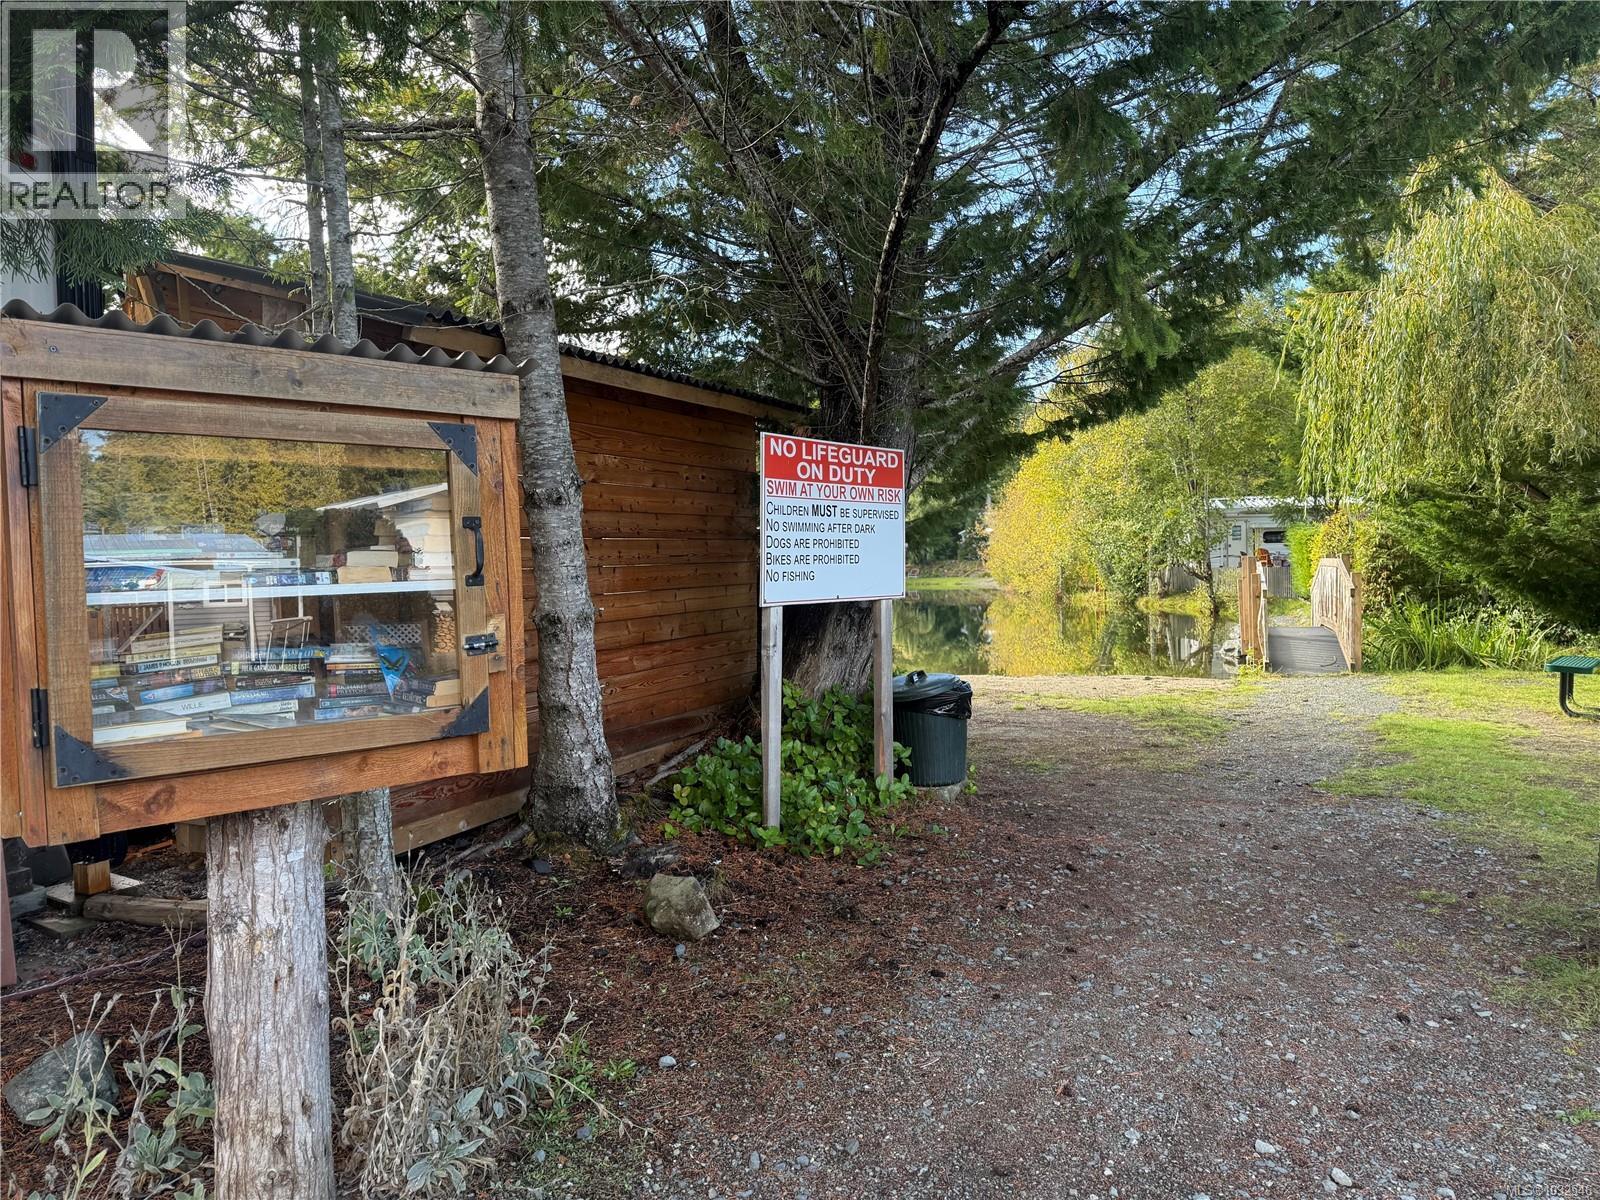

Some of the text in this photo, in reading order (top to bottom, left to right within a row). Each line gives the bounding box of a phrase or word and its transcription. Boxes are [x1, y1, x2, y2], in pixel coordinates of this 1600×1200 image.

[770, 437, 899, 469] NO LIFEGUARD
[797, 462, 877, 485] ON DUTY
[767, 480, 901, 502] SWIM AT YOUR OWN RISK
[811, 505, 838, 518] MUST
[840, 508, 850, 519] BE
[852, 509, 899, 520] SUPERVISED
[782, 521, 825, 533] SWIMMING
[827, 523, 853, 534] AFTER
[855, 524, 876, 534] DARK
[794, 539, 811, 549] ARE
[812, 539, 860, 549] PROHIBITED
[794, 555, 811, 565] ARE
[812, 554, 860, 565] PROHIBITED
[782, 570, 816, 582] FISHING
